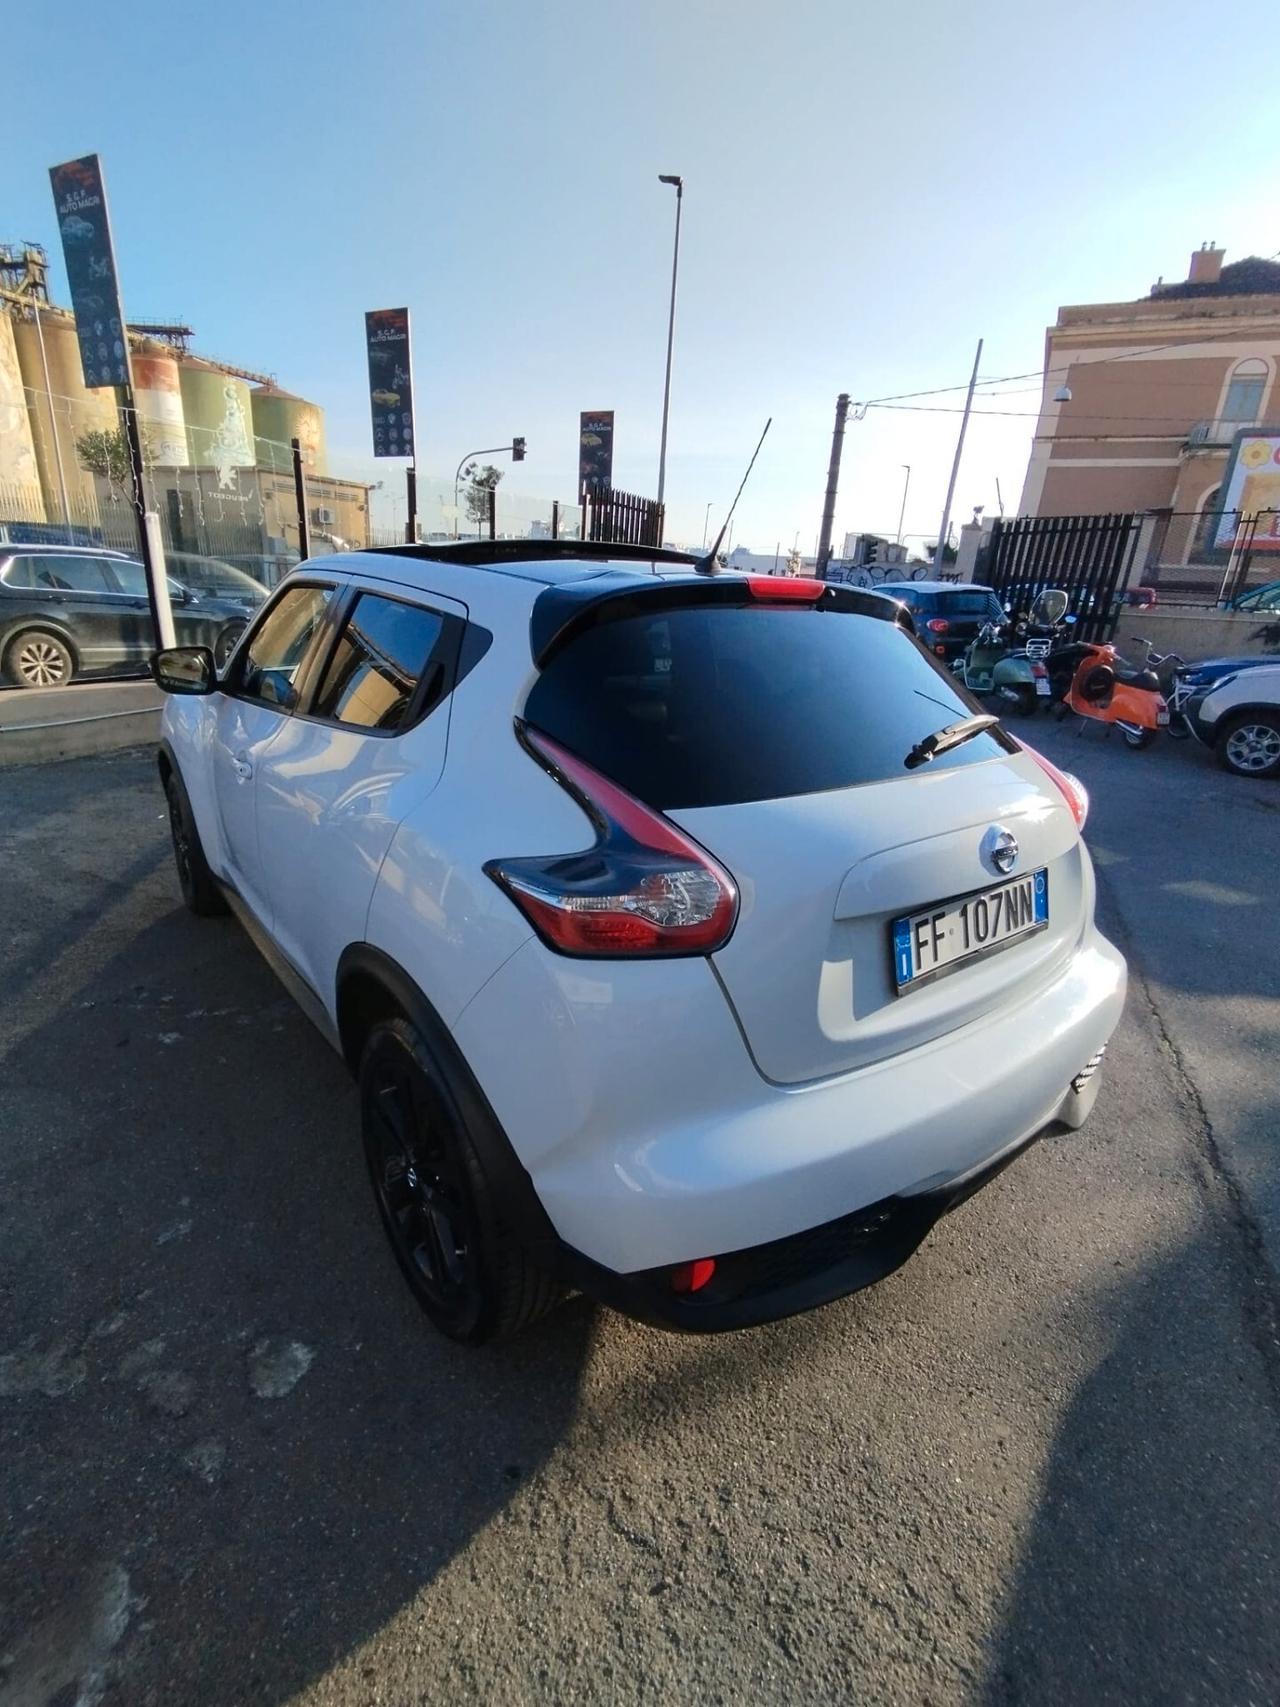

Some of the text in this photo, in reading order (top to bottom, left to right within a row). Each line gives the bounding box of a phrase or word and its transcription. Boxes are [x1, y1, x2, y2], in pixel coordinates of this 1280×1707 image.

[60, 201, 78, 214] AUTO
[915, 911, 946, 971] FF
[959, 881, 1034, 950] 107NN
